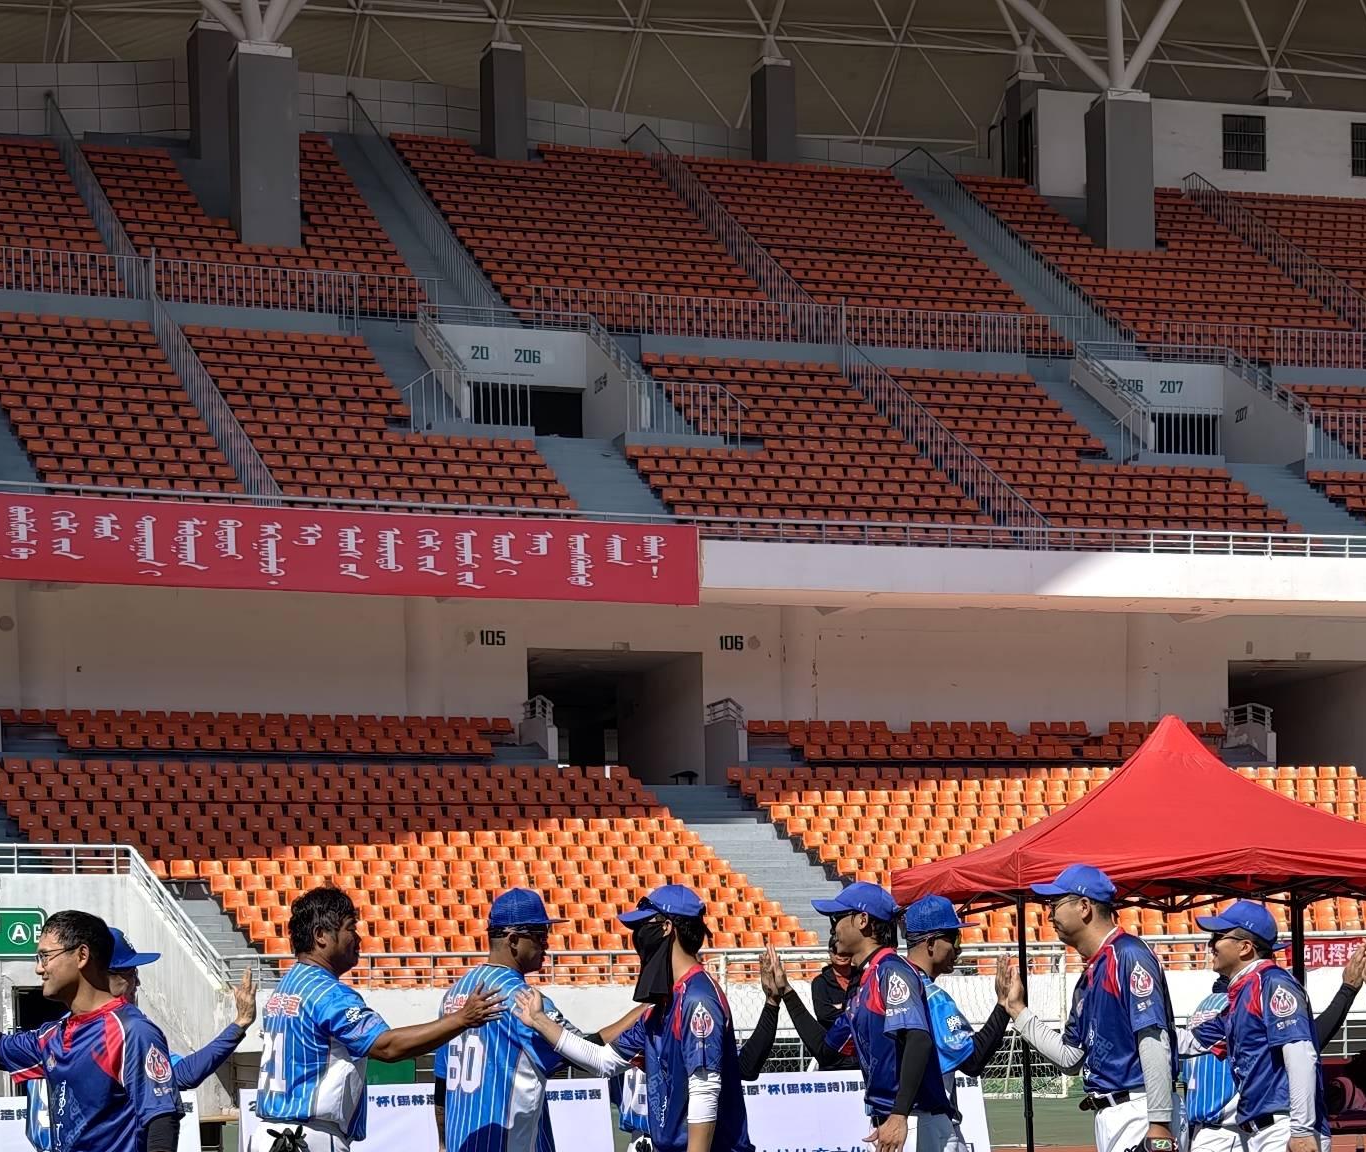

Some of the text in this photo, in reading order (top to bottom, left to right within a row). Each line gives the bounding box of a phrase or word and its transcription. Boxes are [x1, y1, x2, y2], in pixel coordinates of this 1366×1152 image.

[514, 349, 541, 364] 206
[1159, 381, 1184, 394] 207
[479, 630, 506, 646] 105
[718, 634, 744, 652] 106
[11, 924, 28, 941] A
[445, 1034, 485, 1094] 60
